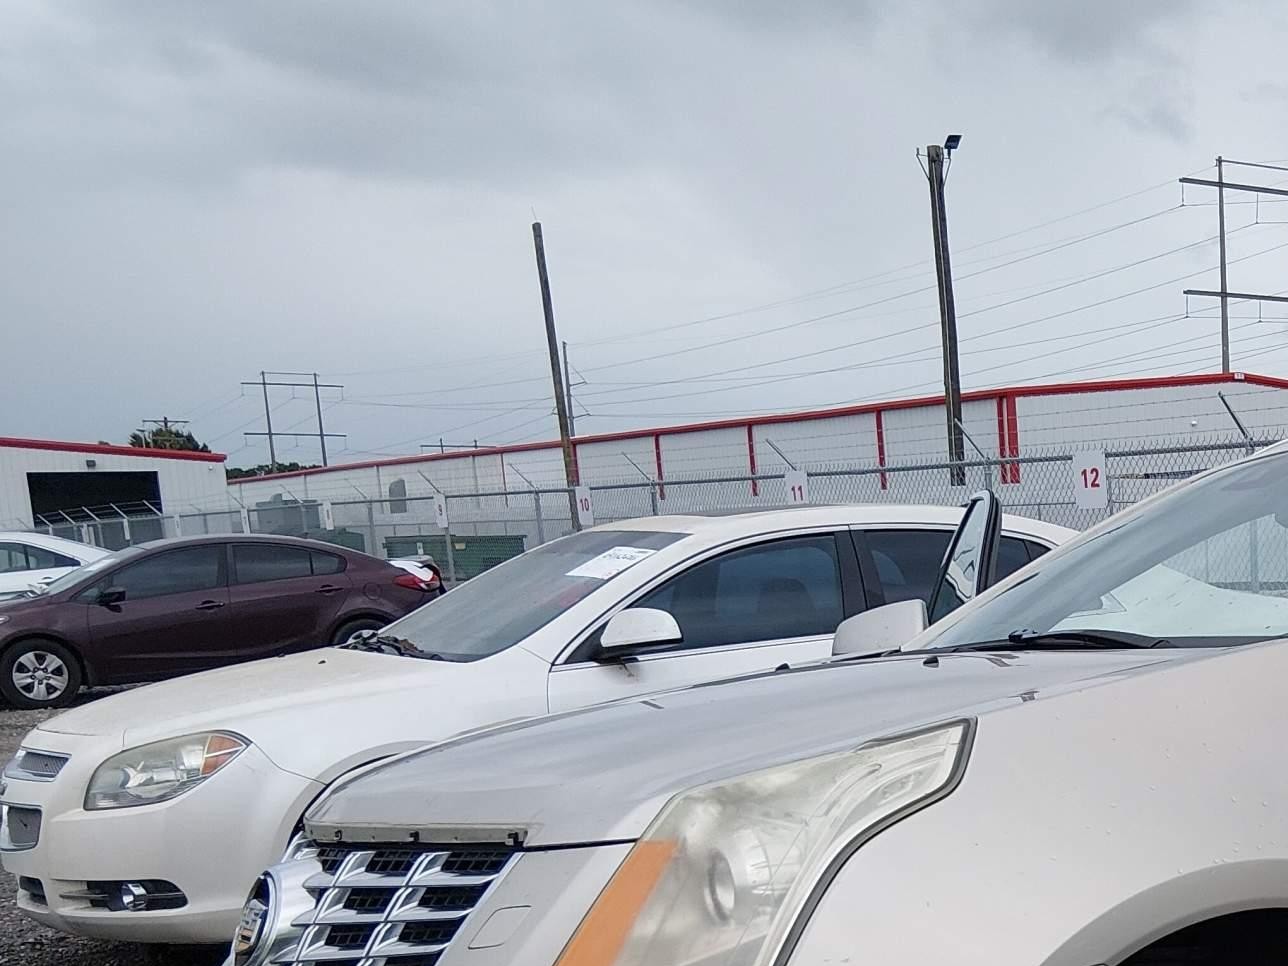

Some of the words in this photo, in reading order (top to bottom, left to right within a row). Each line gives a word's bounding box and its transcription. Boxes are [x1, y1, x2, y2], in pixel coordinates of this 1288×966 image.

[1081, 467, 1100, 488] 12
[791, 485, 803, 501] 11
[580, 497, 590, 511] 10
